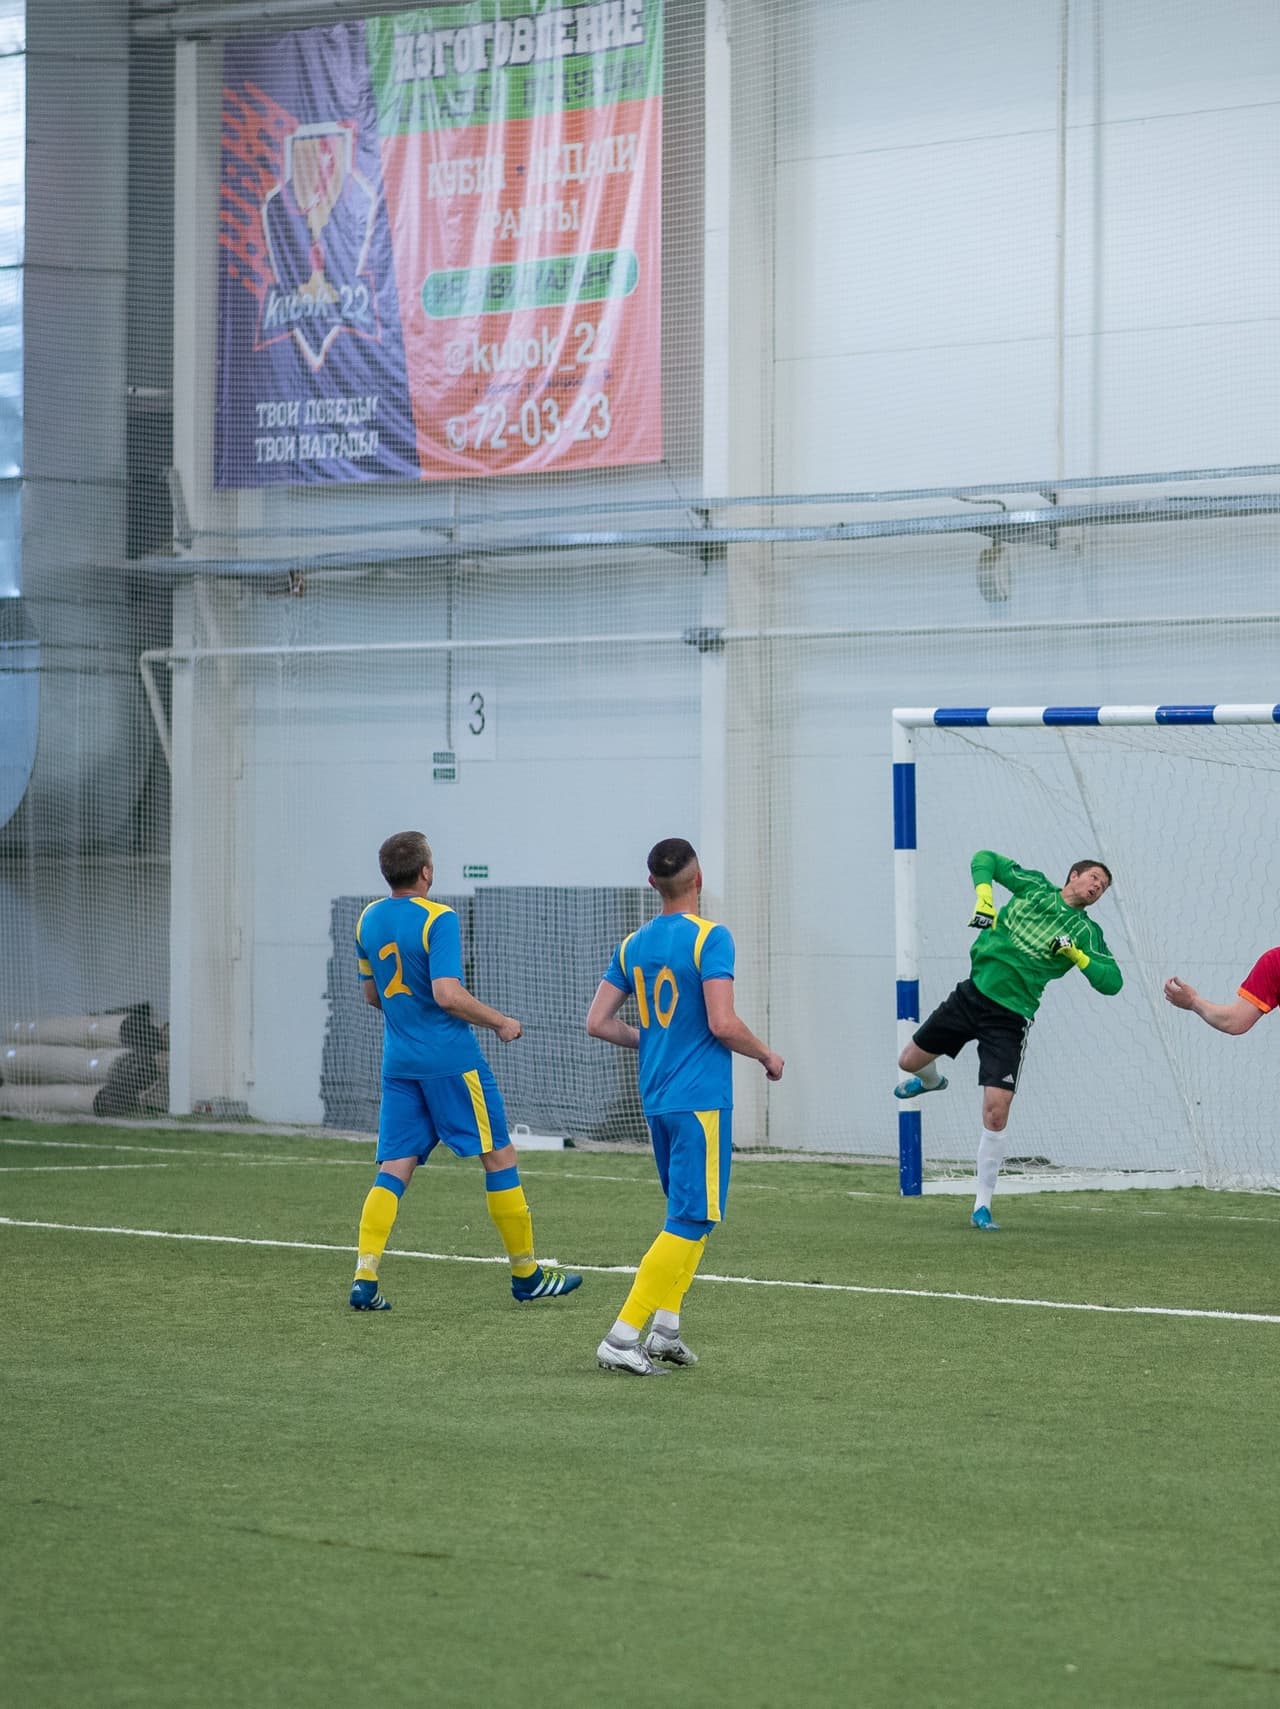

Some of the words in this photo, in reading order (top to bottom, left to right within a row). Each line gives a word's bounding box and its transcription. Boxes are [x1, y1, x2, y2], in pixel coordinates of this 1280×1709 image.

[473, 391, 611, 449] 72-03-23
[469, 692, 485, 735] 3
[379, 942, 413, 998] 2
[633, 965, 679, 1029] 10
